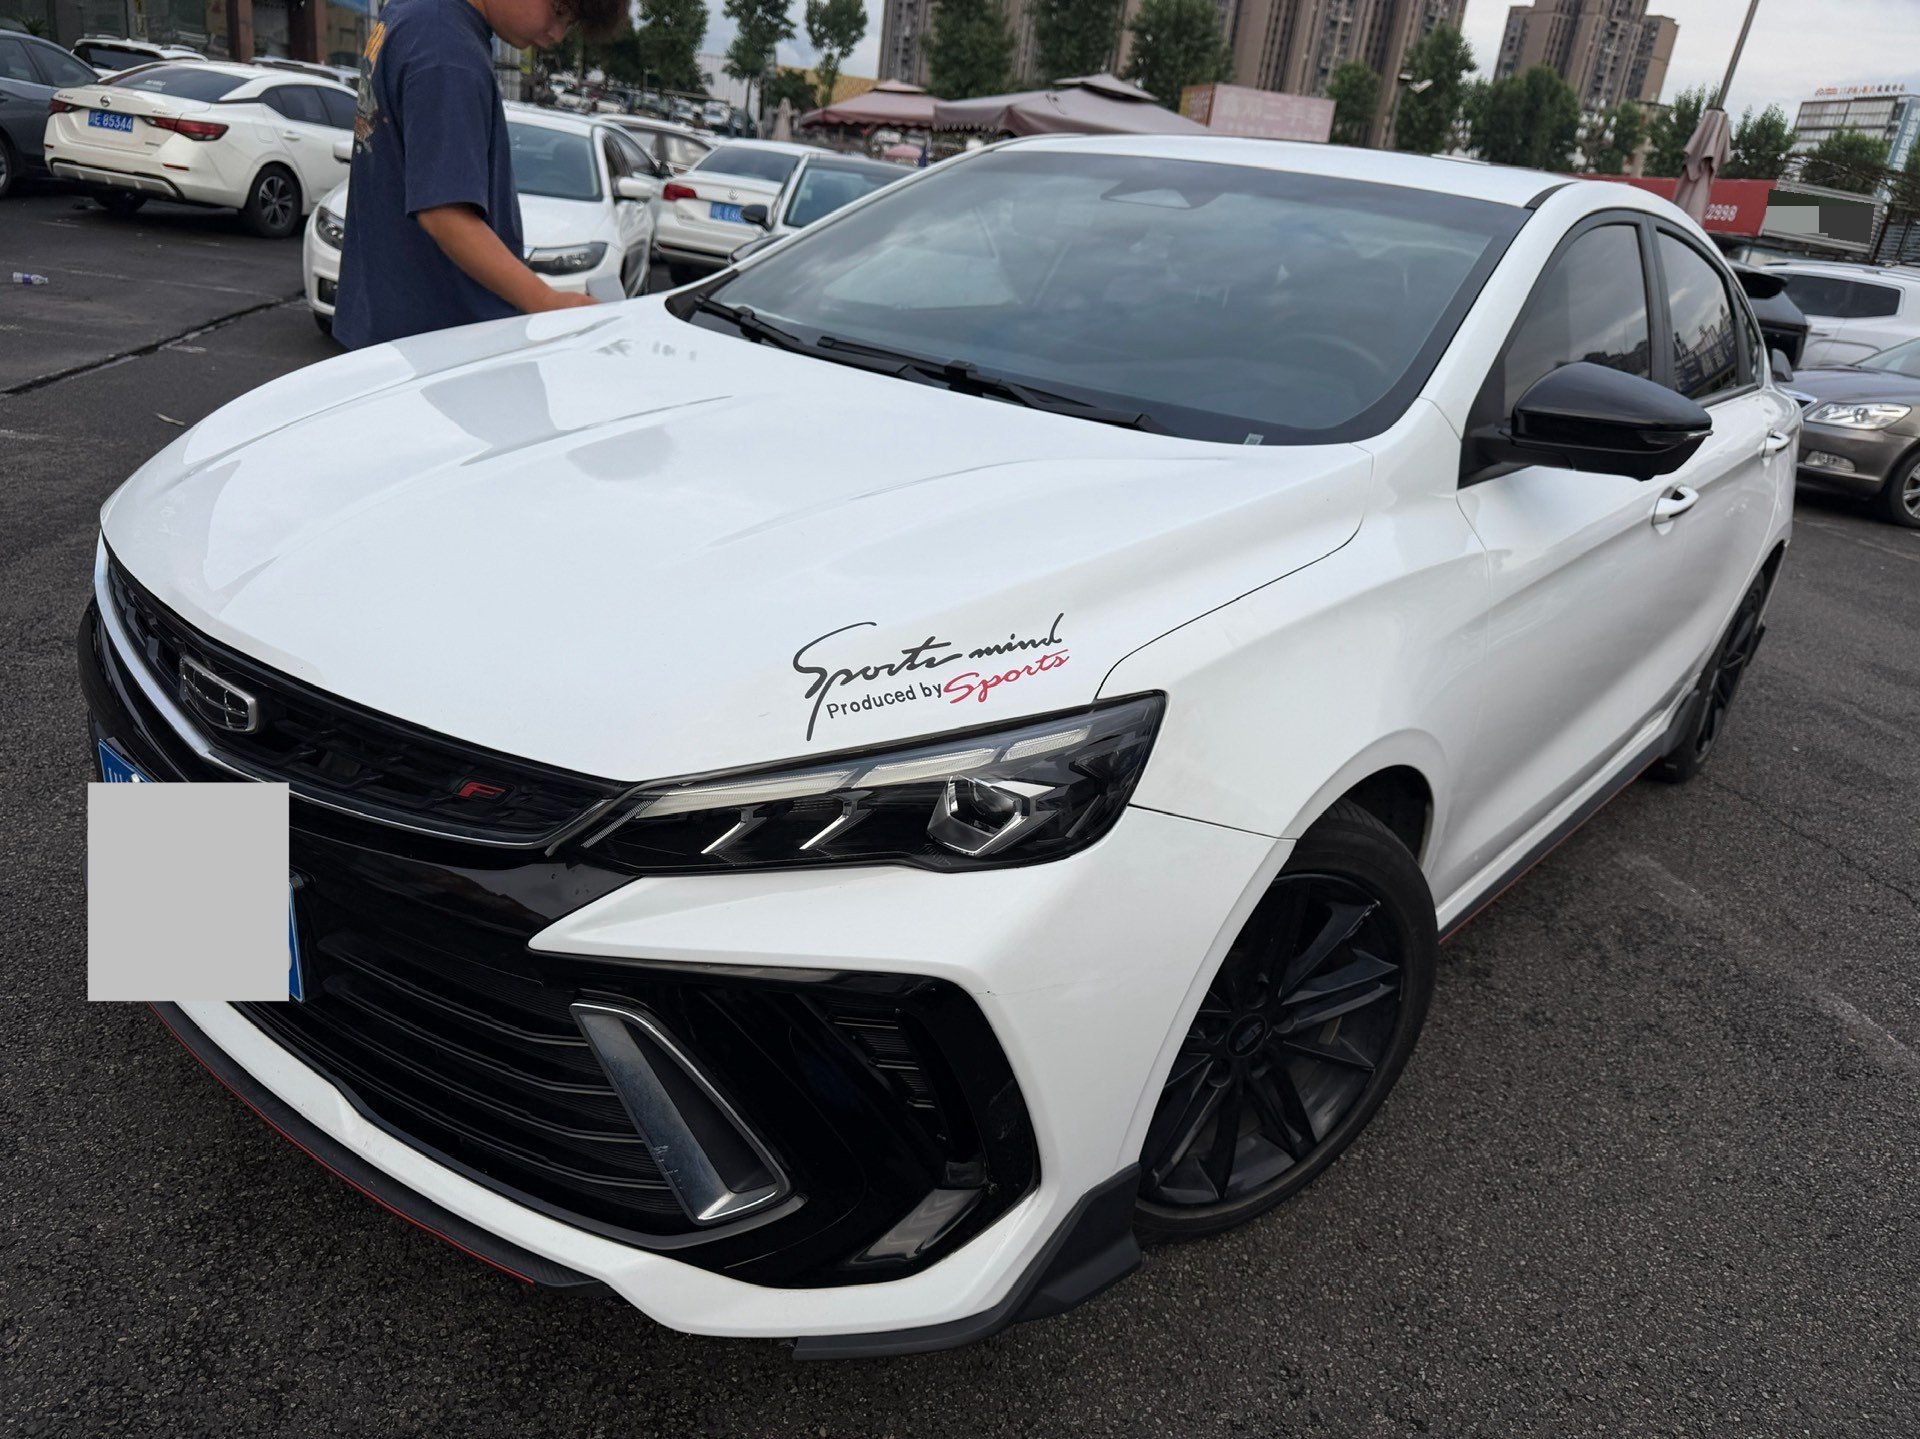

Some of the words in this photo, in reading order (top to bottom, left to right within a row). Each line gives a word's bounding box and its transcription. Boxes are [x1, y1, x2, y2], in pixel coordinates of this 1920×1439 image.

[793, 621, 963, 742] Sports
[968, 612, 1064, 658] mind
[826, 684, 917, 719] Produced
[921, 682, 943, 699] by
[943, 648, 1070, 705] Sports
